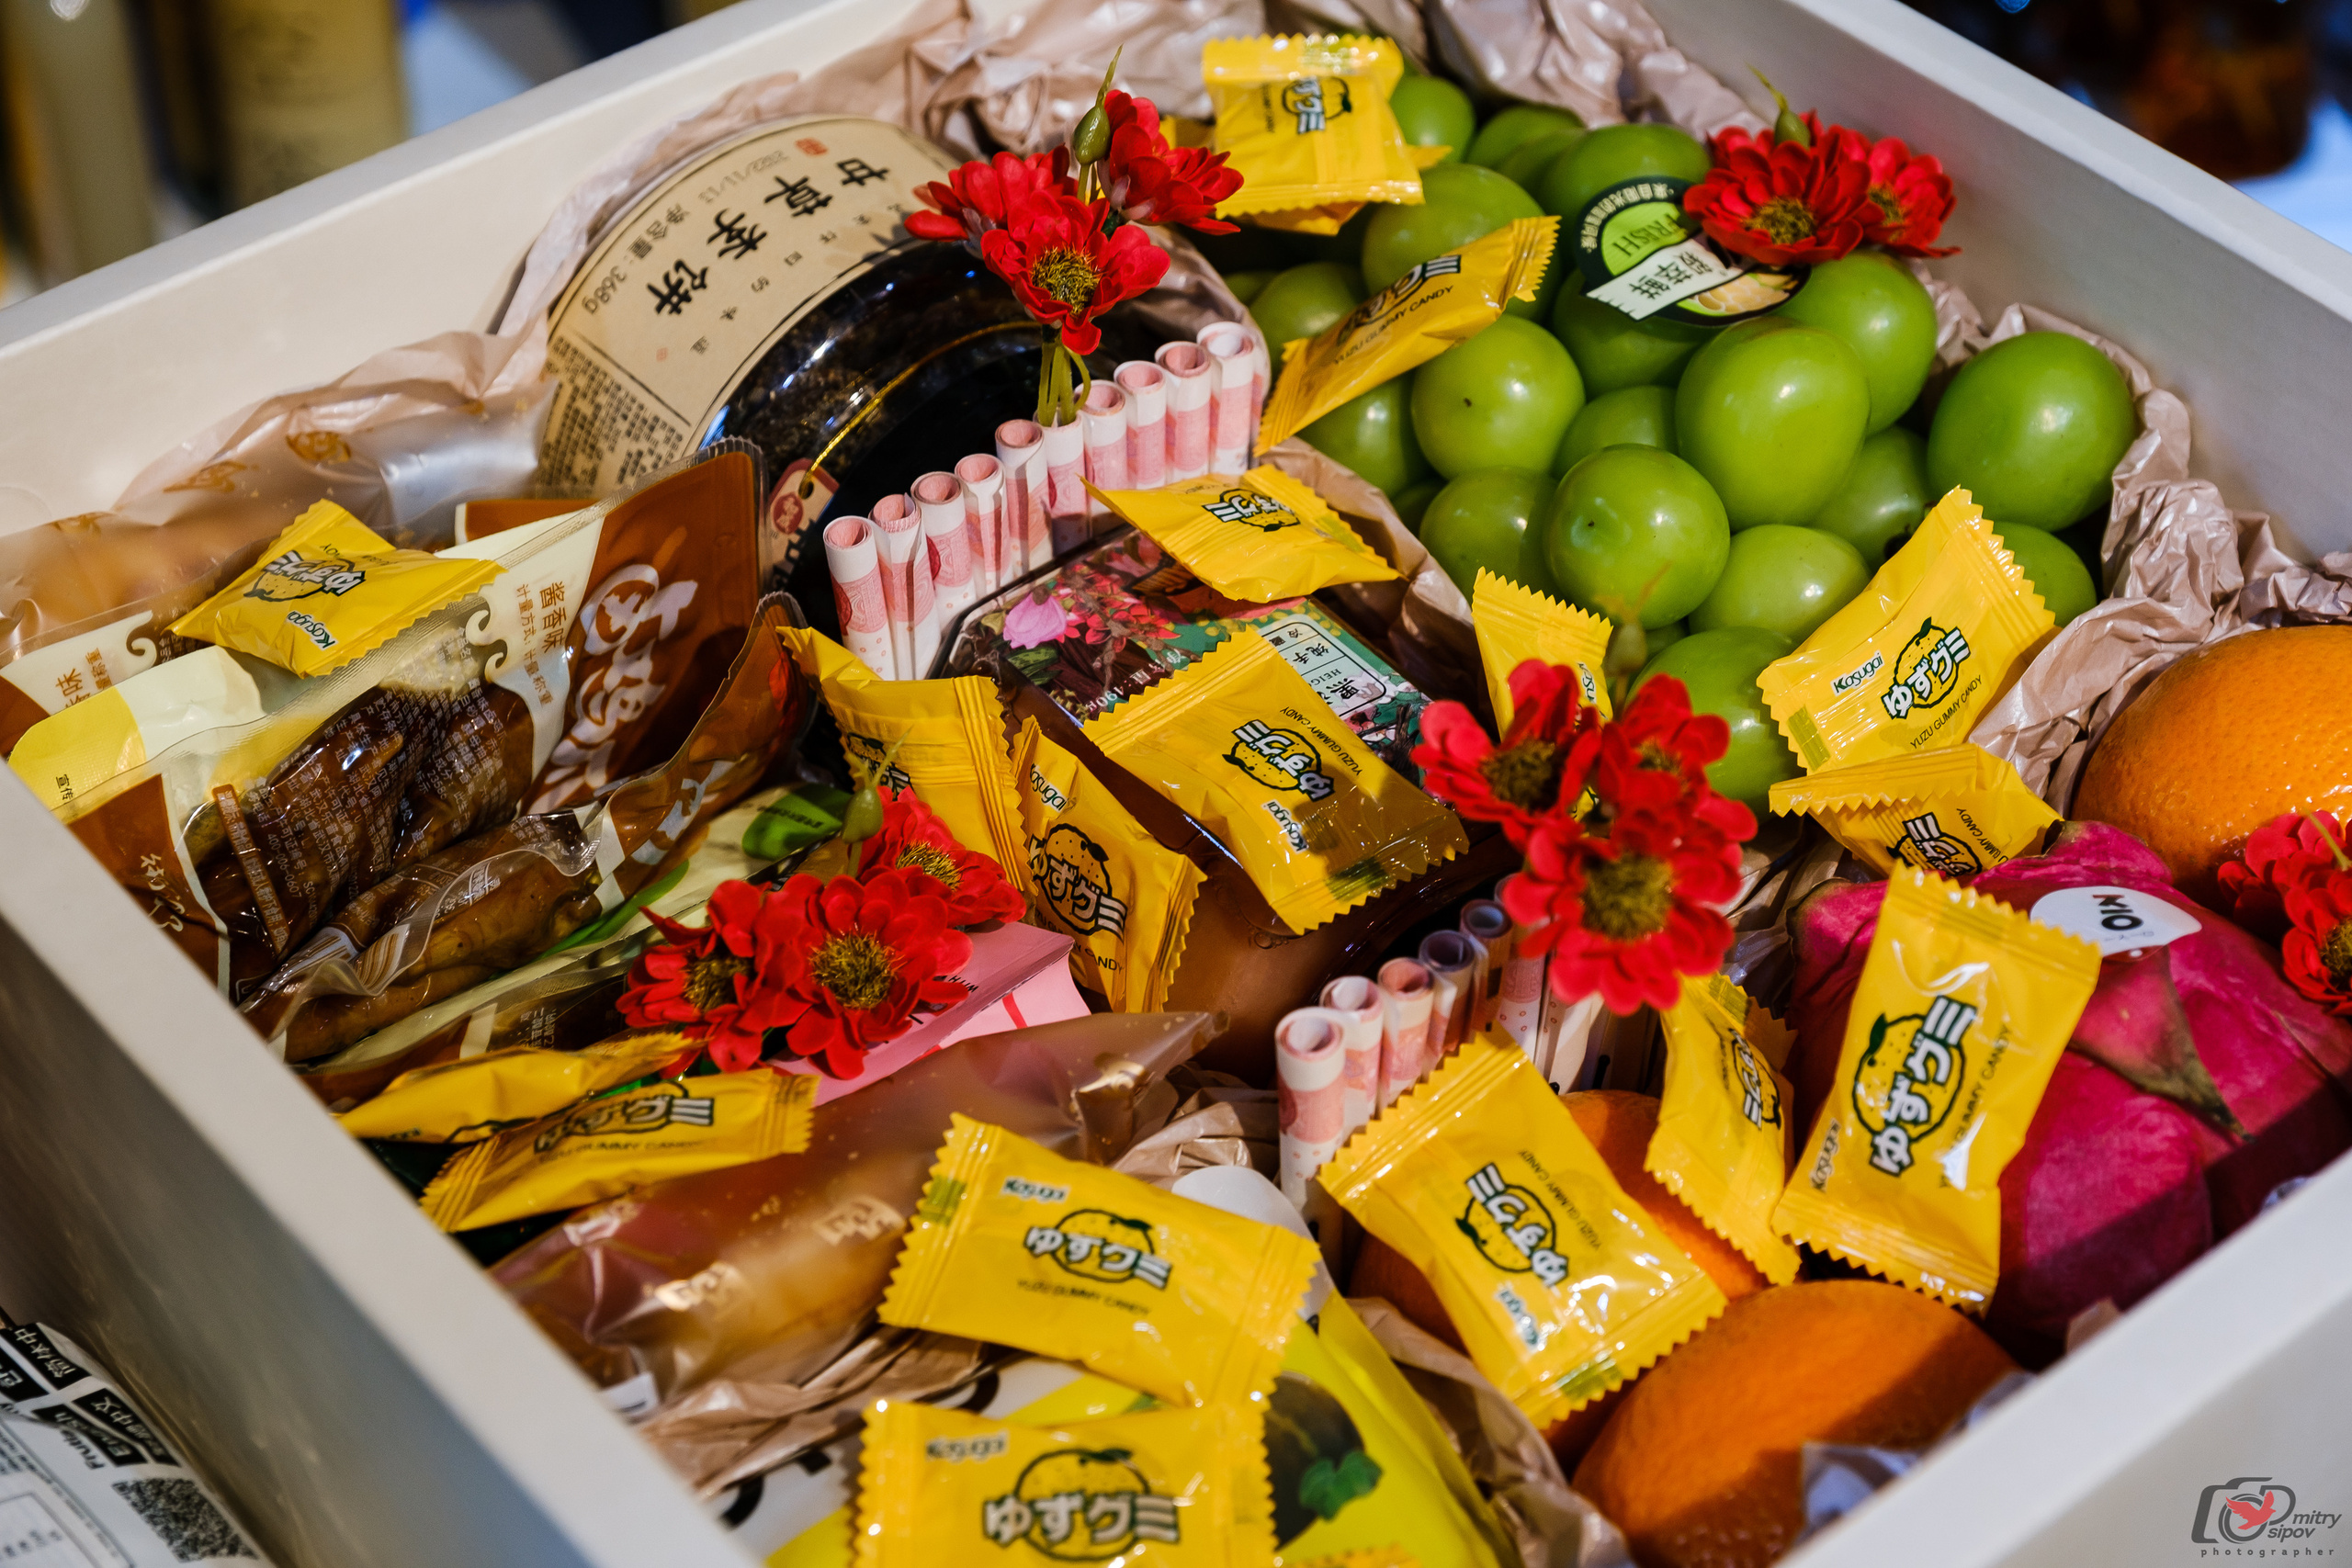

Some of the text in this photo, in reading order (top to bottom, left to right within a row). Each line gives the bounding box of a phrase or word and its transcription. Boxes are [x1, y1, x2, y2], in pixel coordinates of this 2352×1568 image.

[645, 155, 893, 317] 甘草李饼
[1408, 283, 1455, 315] CANDY
[287, 610, 335, 649] Kasugai
[538, 581, 568, 652] 酱香味
[1832, 653, 1884, 694] Kasugai
[1881, 626, 1971, 720] ゆずグミ
[1280, 705, 1363, 776] YUZU GUMMY CANDY
[1910, 674, 1983, 750] YUZU GUMMY CANDY
[1232, 719, 1335, 802] ゆずグミ
[1956, 805, 1984, 839] CANDY
[266, 830, 303, 900] 400-006-0607
[1870, 995, 1978, 1177] ゆずグミ
[1023, 1224, 1172, 1291] ゆずグミ
[1464, 1162, 1569, 1288] ゆずグミ
[983, 1491, 1180, 1547] ゆずグミ
